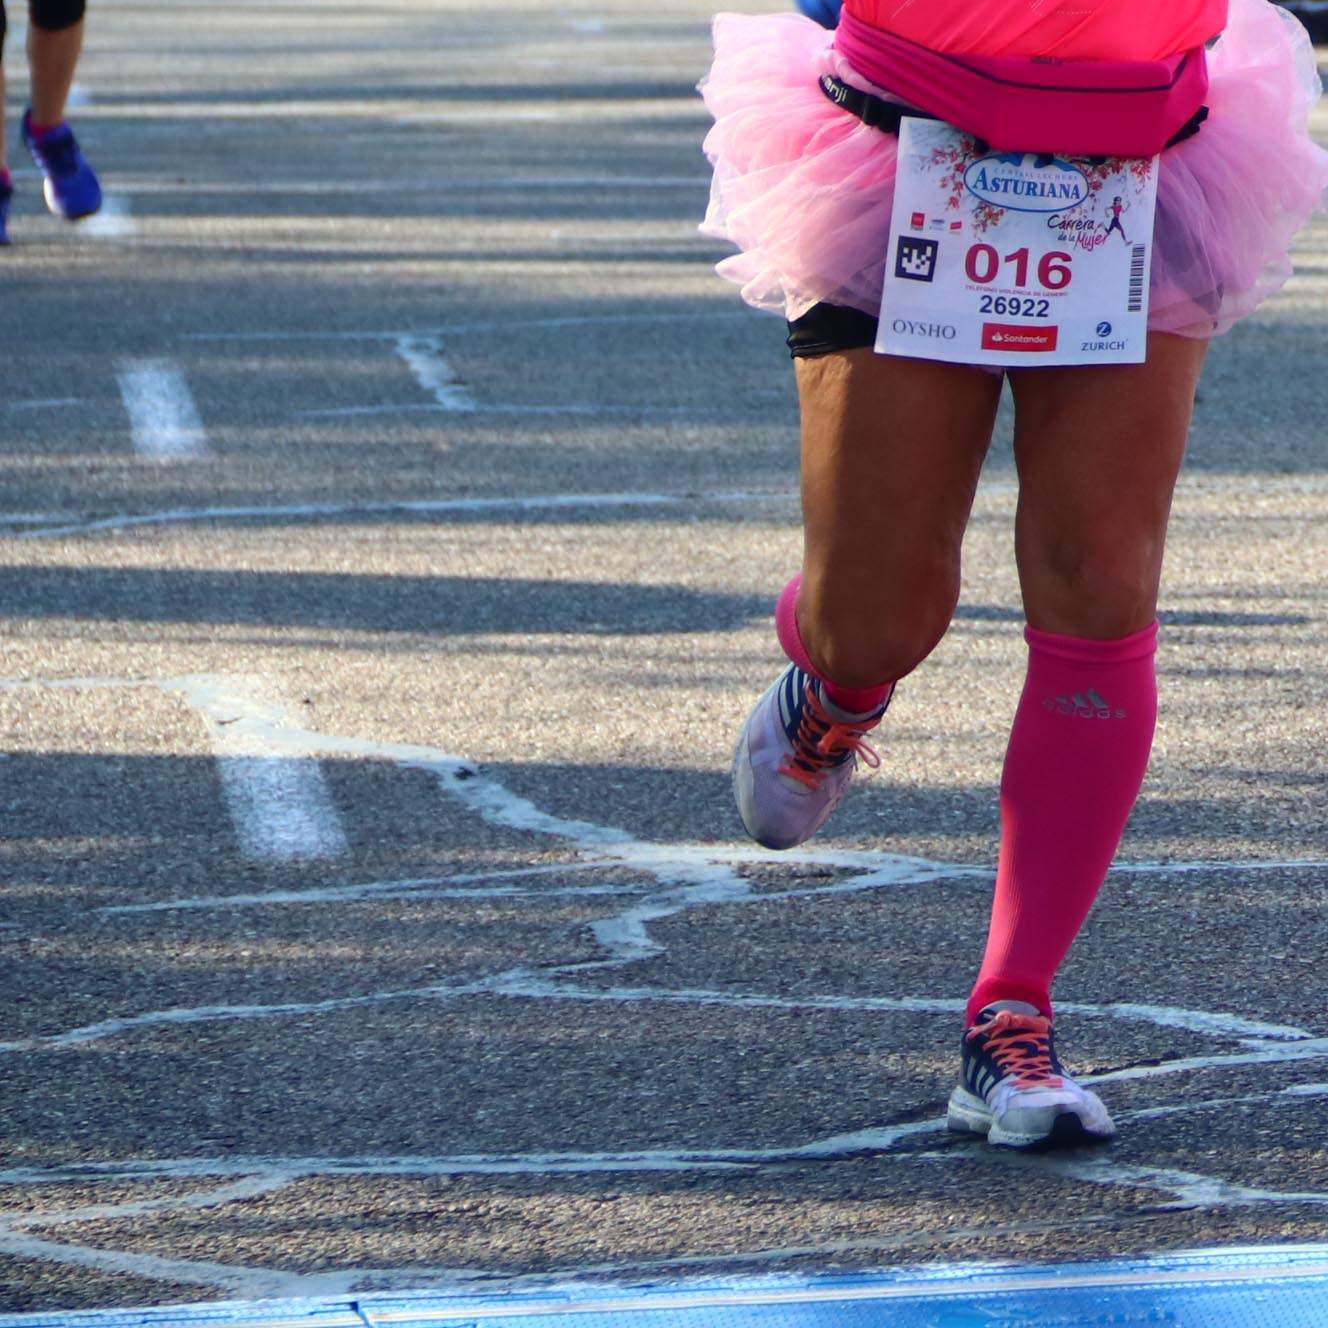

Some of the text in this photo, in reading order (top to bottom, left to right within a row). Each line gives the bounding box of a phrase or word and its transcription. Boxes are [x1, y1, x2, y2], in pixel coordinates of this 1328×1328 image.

[973, 167, 1081, 200] ASTURIANA
[1047, 214, 1095, 231] Carrera
[1074, 231, 1109, 252] Mujer
[965, 243, 1073, 290] 016
[979, 294, 1050, 318] 26922
[893, 319, 1125, 351] OYSHO Santander ZURICH
